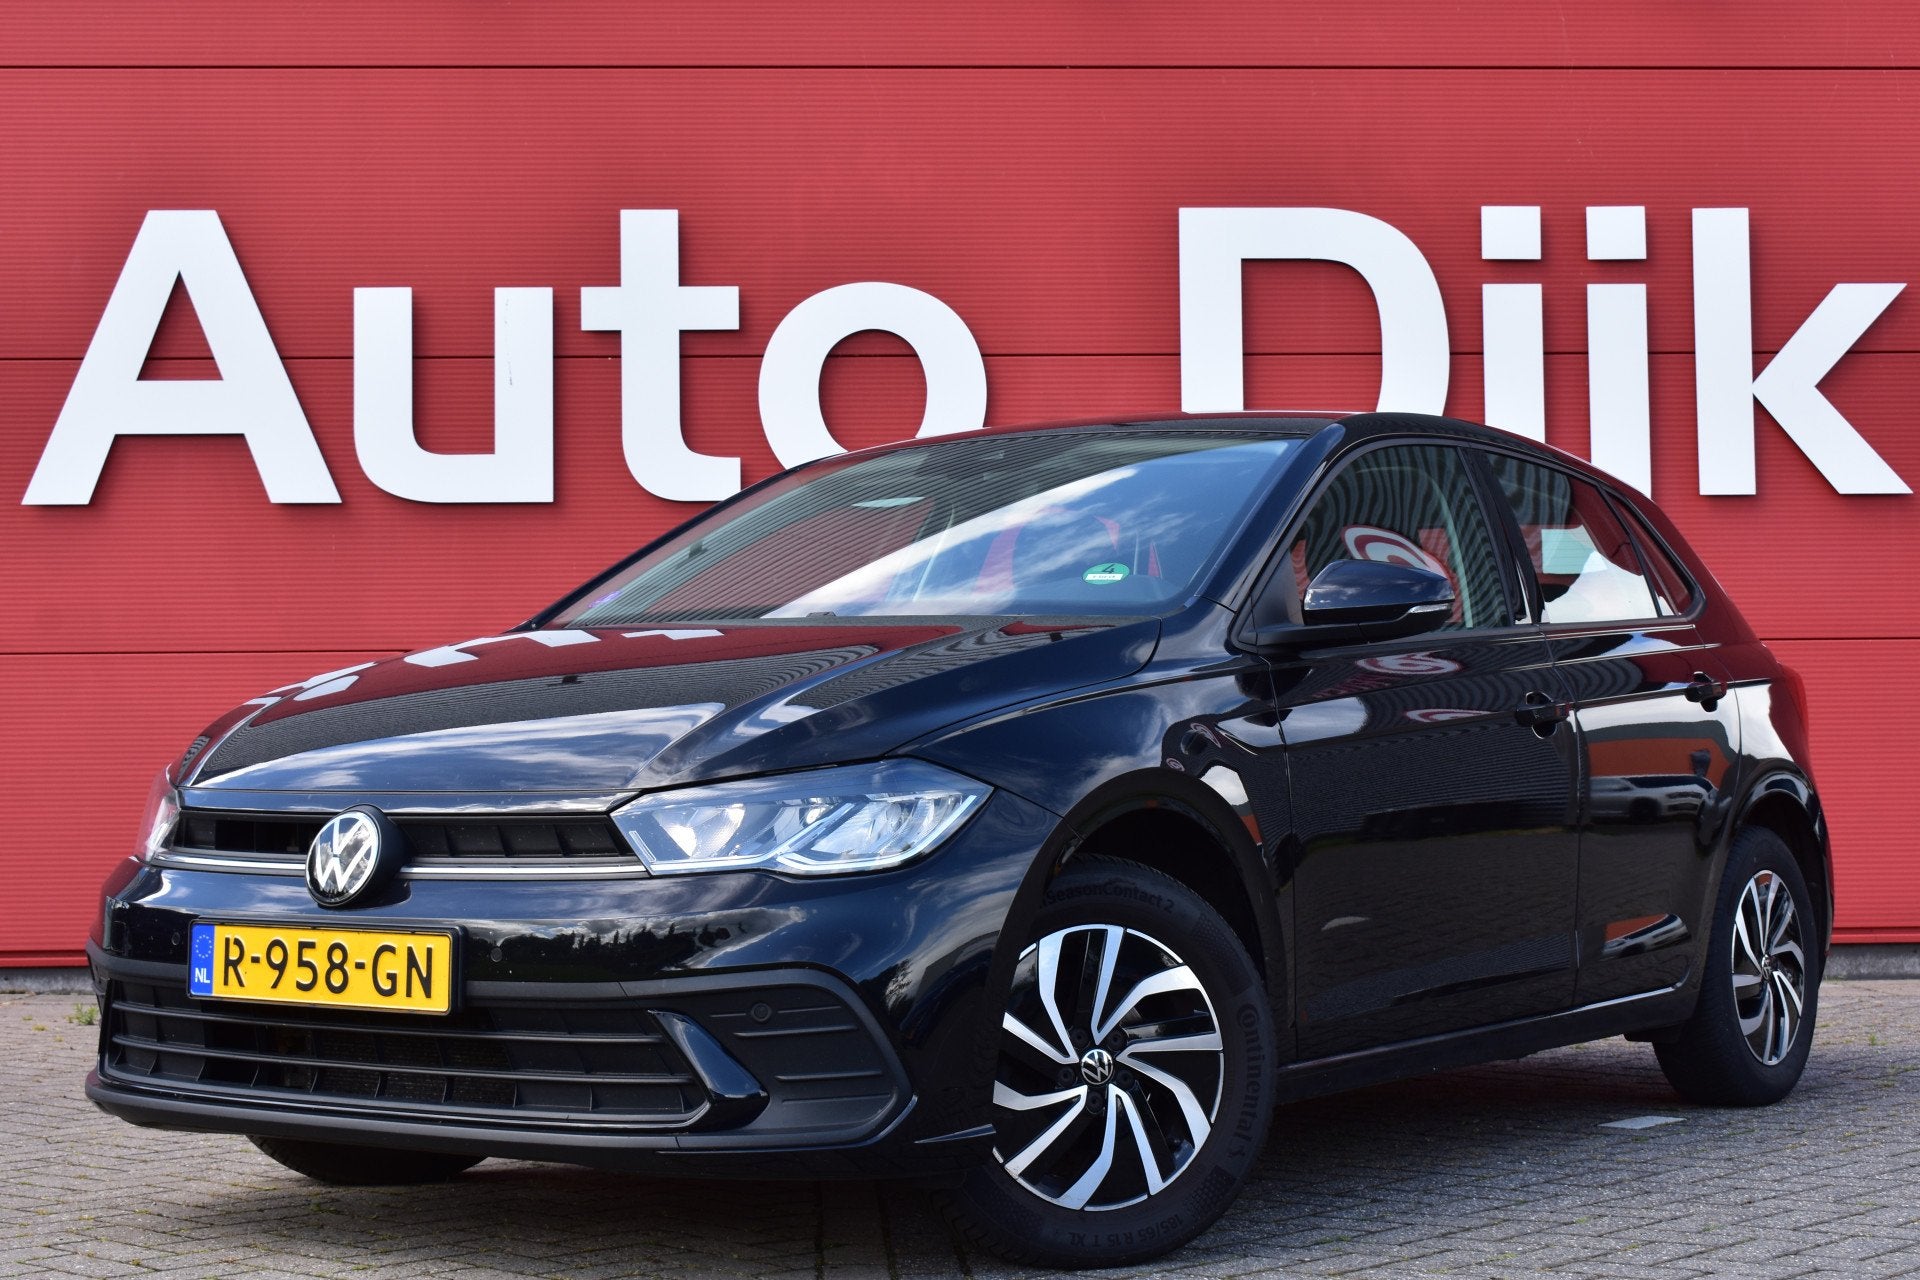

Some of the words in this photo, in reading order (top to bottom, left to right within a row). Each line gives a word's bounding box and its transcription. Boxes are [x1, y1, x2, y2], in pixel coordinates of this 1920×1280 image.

[21, 208, 988, 504] Auto
[1178, 205, 1914, 498] Dijk
[1101, 563, 1115, 574] 4
[1163, 898, 1175, 914] 2
[194, 967, 211, 985] NL
[222, 935, 433, 999] R-958-GN
[1232, 1003, 1266, 1142] Continental
